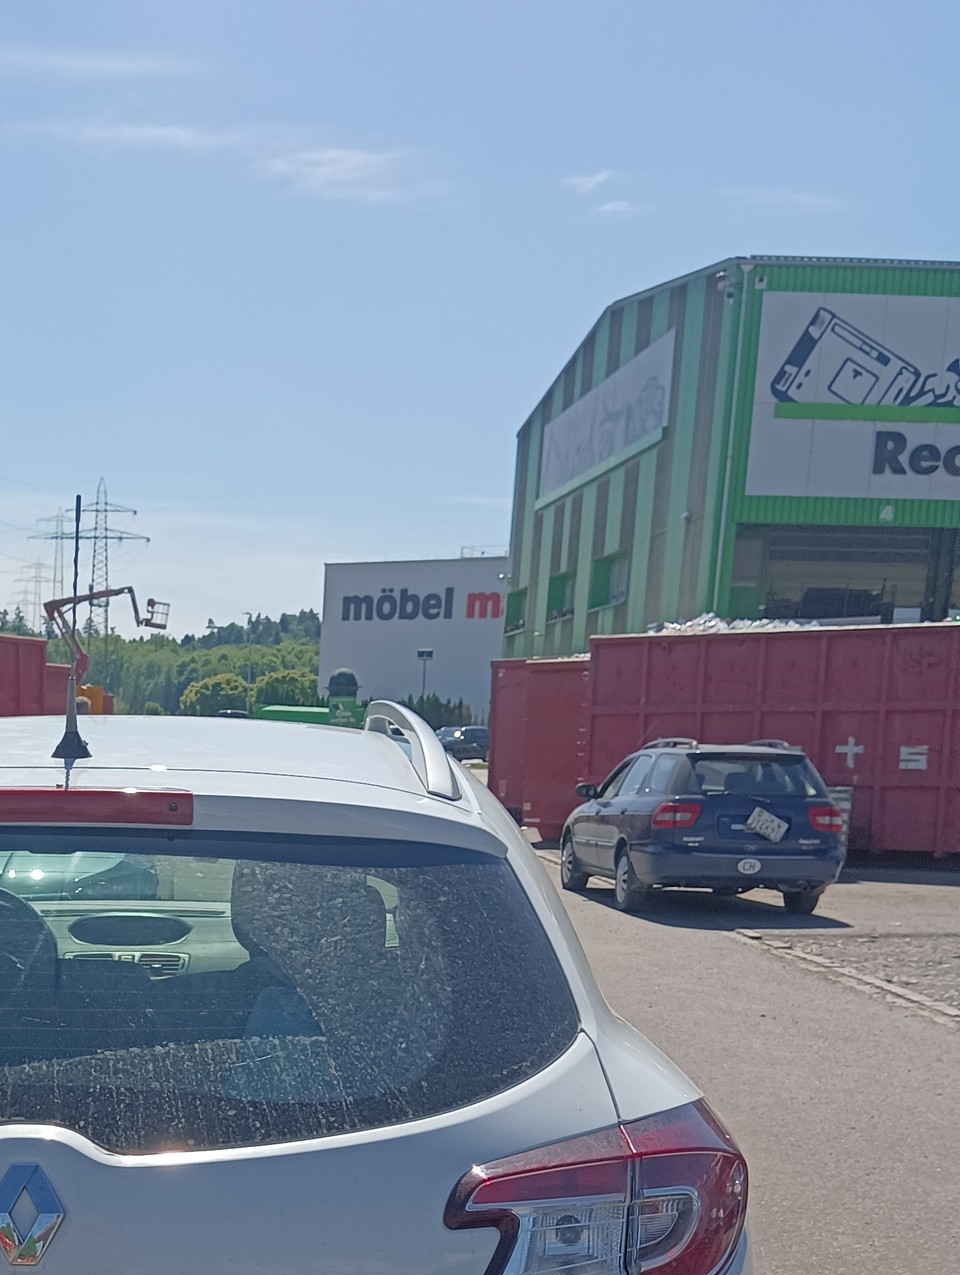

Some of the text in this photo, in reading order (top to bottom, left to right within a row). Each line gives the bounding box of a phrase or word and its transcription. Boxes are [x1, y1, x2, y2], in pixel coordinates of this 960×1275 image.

[880, 505, 894, 521] 4
[341, 587, 506, 621] möbel m
[742, 861, 756, 871] CH
